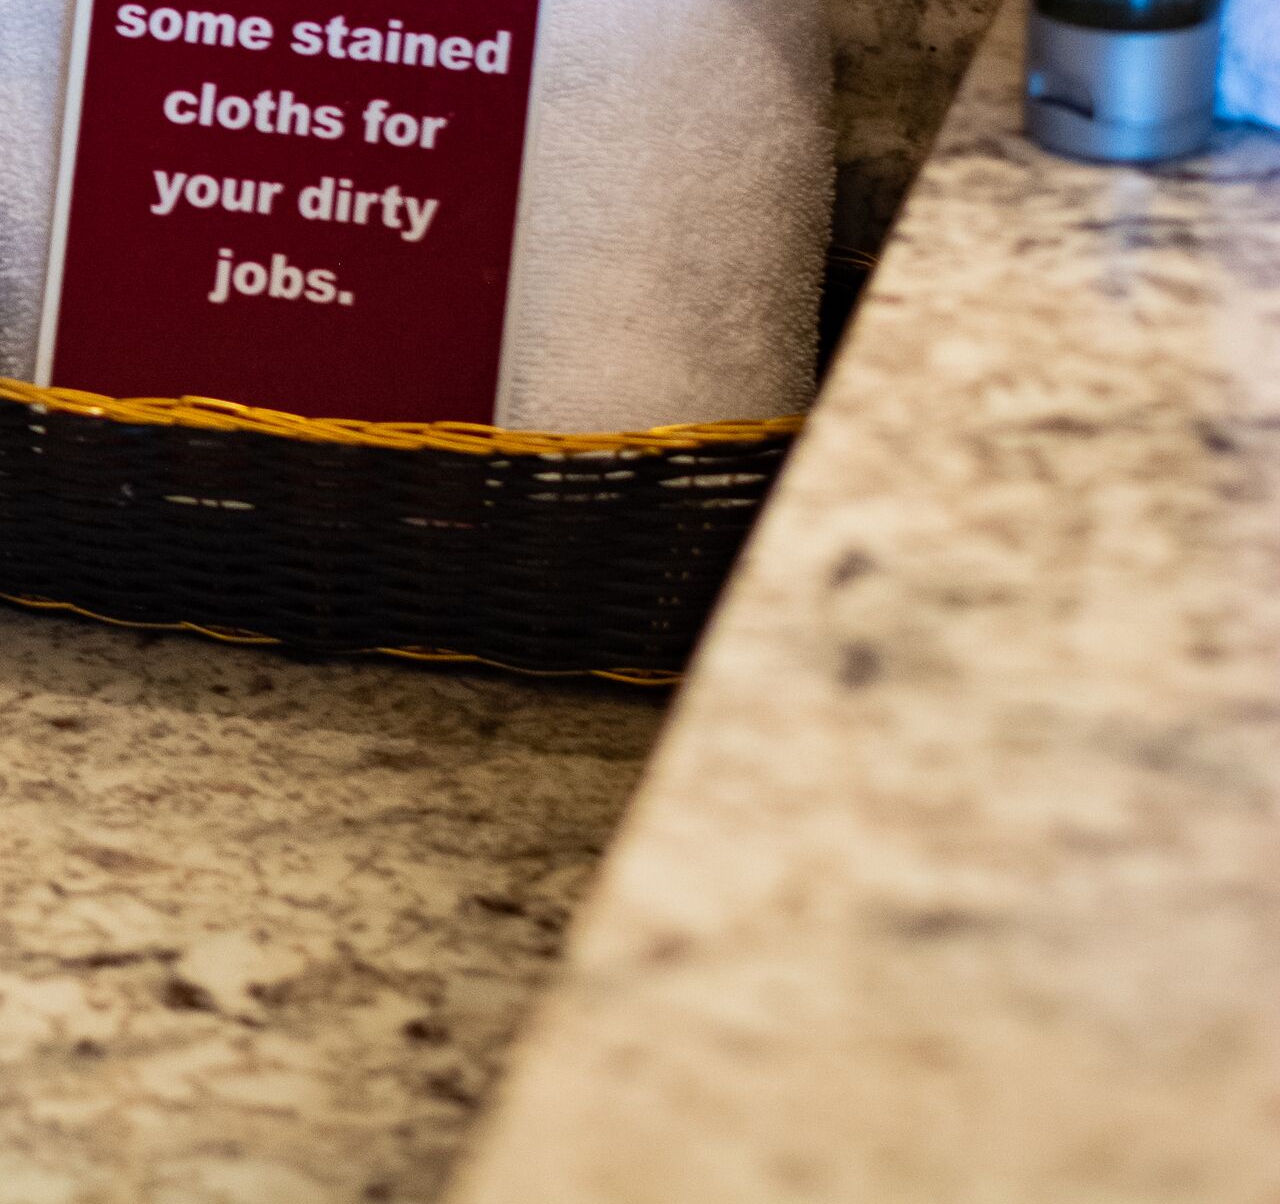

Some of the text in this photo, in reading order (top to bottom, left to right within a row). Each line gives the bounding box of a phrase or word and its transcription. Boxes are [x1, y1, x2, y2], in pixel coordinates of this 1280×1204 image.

[114, 2, 512, 75] some stained
[163, 81, 449, 150] cloths for
[149, 169, 440, 243] your dirty
[208, 247, 354, 306] jobs.
